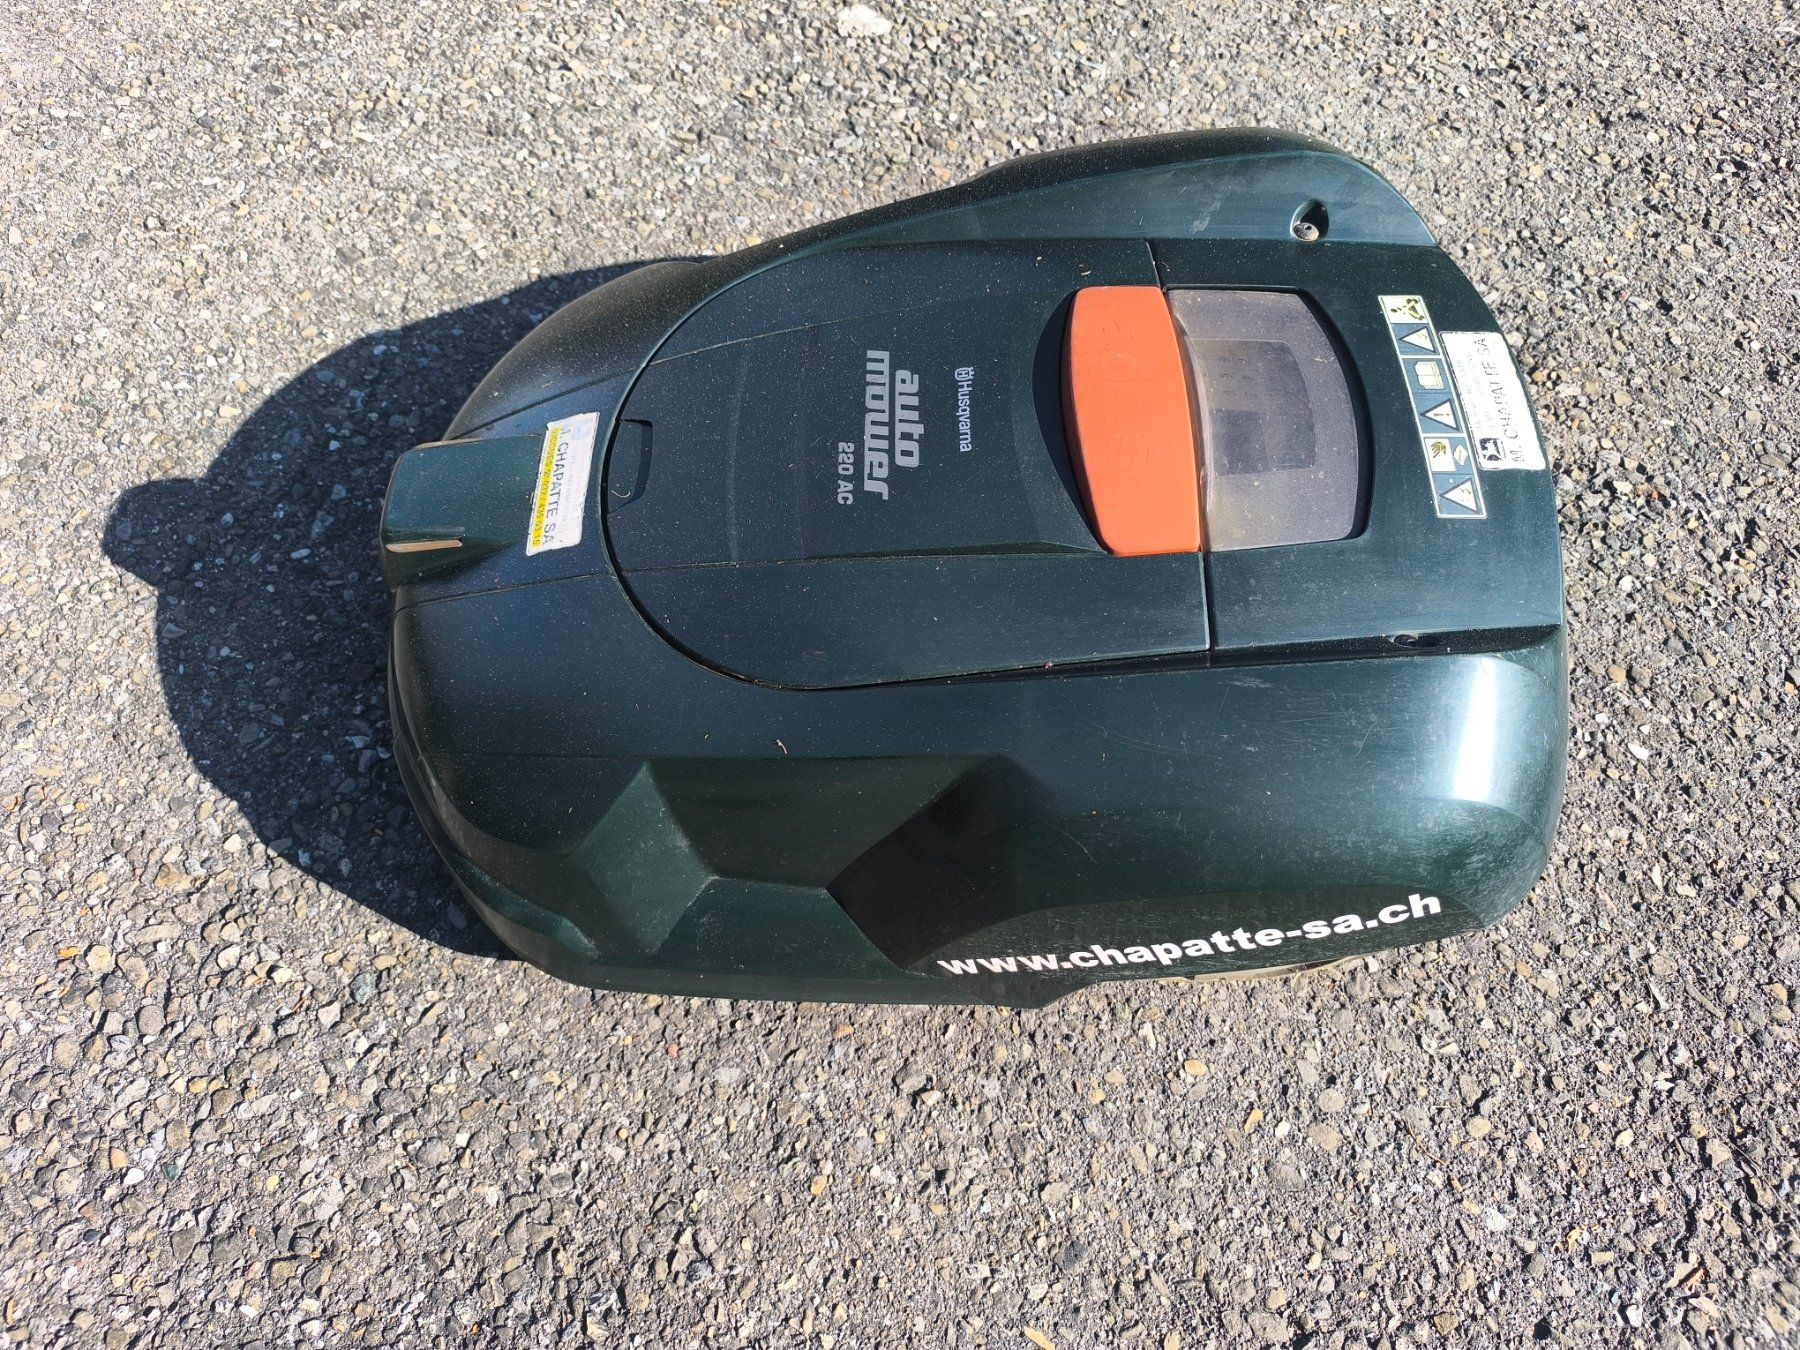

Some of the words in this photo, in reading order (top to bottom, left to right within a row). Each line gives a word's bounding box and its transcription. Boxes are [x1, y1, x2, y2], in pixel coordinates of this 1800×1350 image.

[863, 350, 890, 500] mower
[894, 369, 925, 468] auto
[956, 381, 973, 453] Husqvarna
[546, 443, 569, 518] CHAPATTE
[837, 441, 855, 475] 220
[837, 480, 854, 505] AC
[542, 523, 556, 545] SA
[937, 893, 1442, 975] www.chapatte-sa.ch
